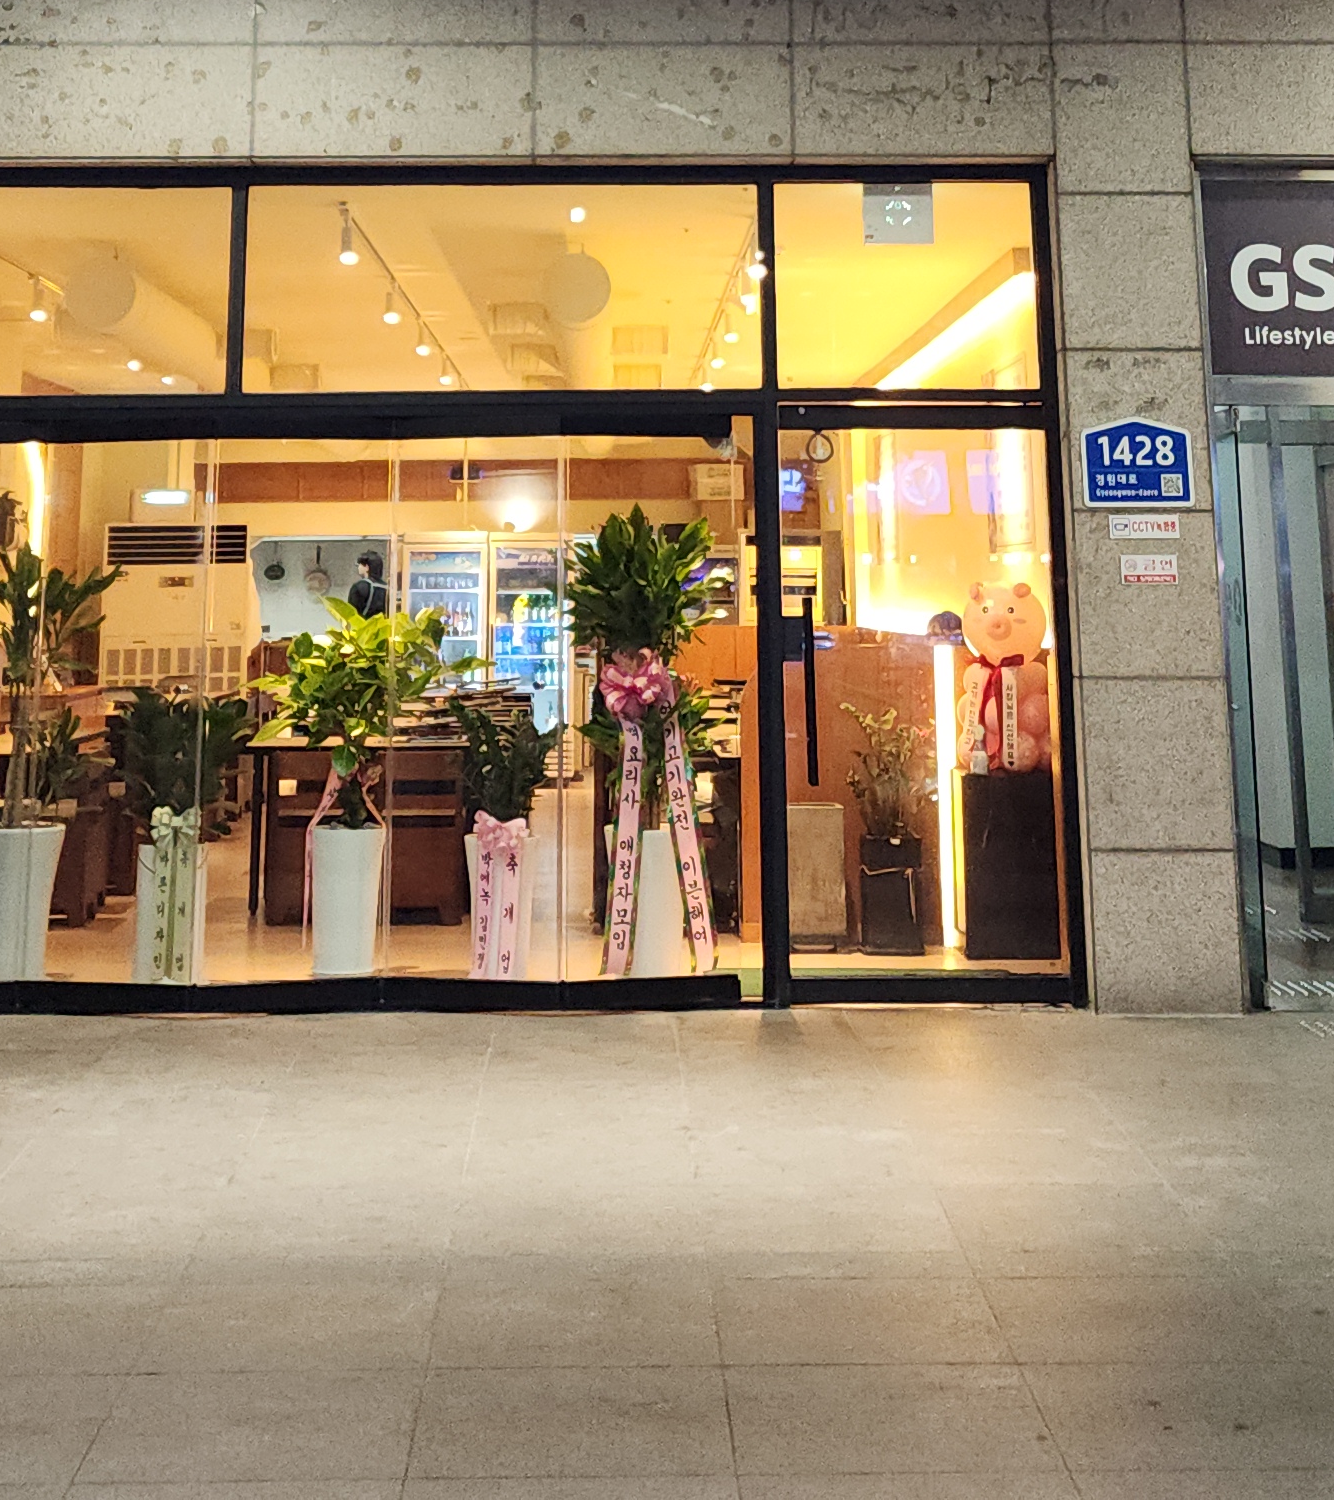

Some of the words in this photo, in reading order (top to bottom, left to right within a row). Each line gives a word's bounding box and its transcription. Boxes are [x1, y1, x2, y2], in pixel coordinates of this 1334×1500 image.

[1095, 473, 1139, 486] 경원대로
[1097, 435, 1176, 467] 1428
[611, 836, 635, 951] 애청자모임
[682, 856, 708, 946] 이븐해여
